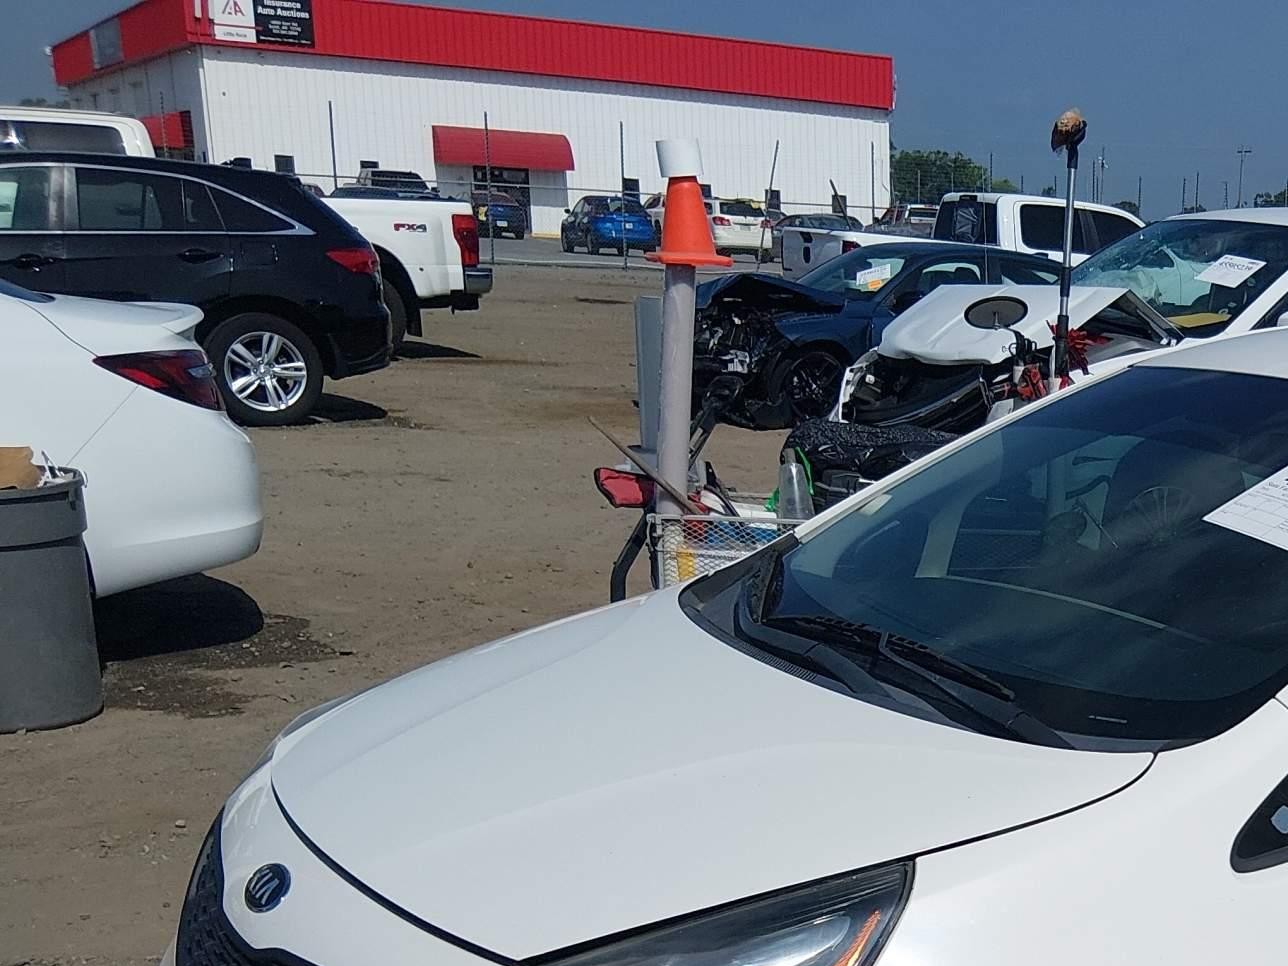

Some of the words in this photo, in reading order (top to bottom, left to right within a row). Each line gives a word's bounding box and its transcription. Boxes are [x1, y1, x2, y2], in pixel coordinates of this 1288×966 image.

[257, 6, 275, 15] Auto
[276, 8, 310, 19] Auctions
[393, 223, 428, 232] FX4
